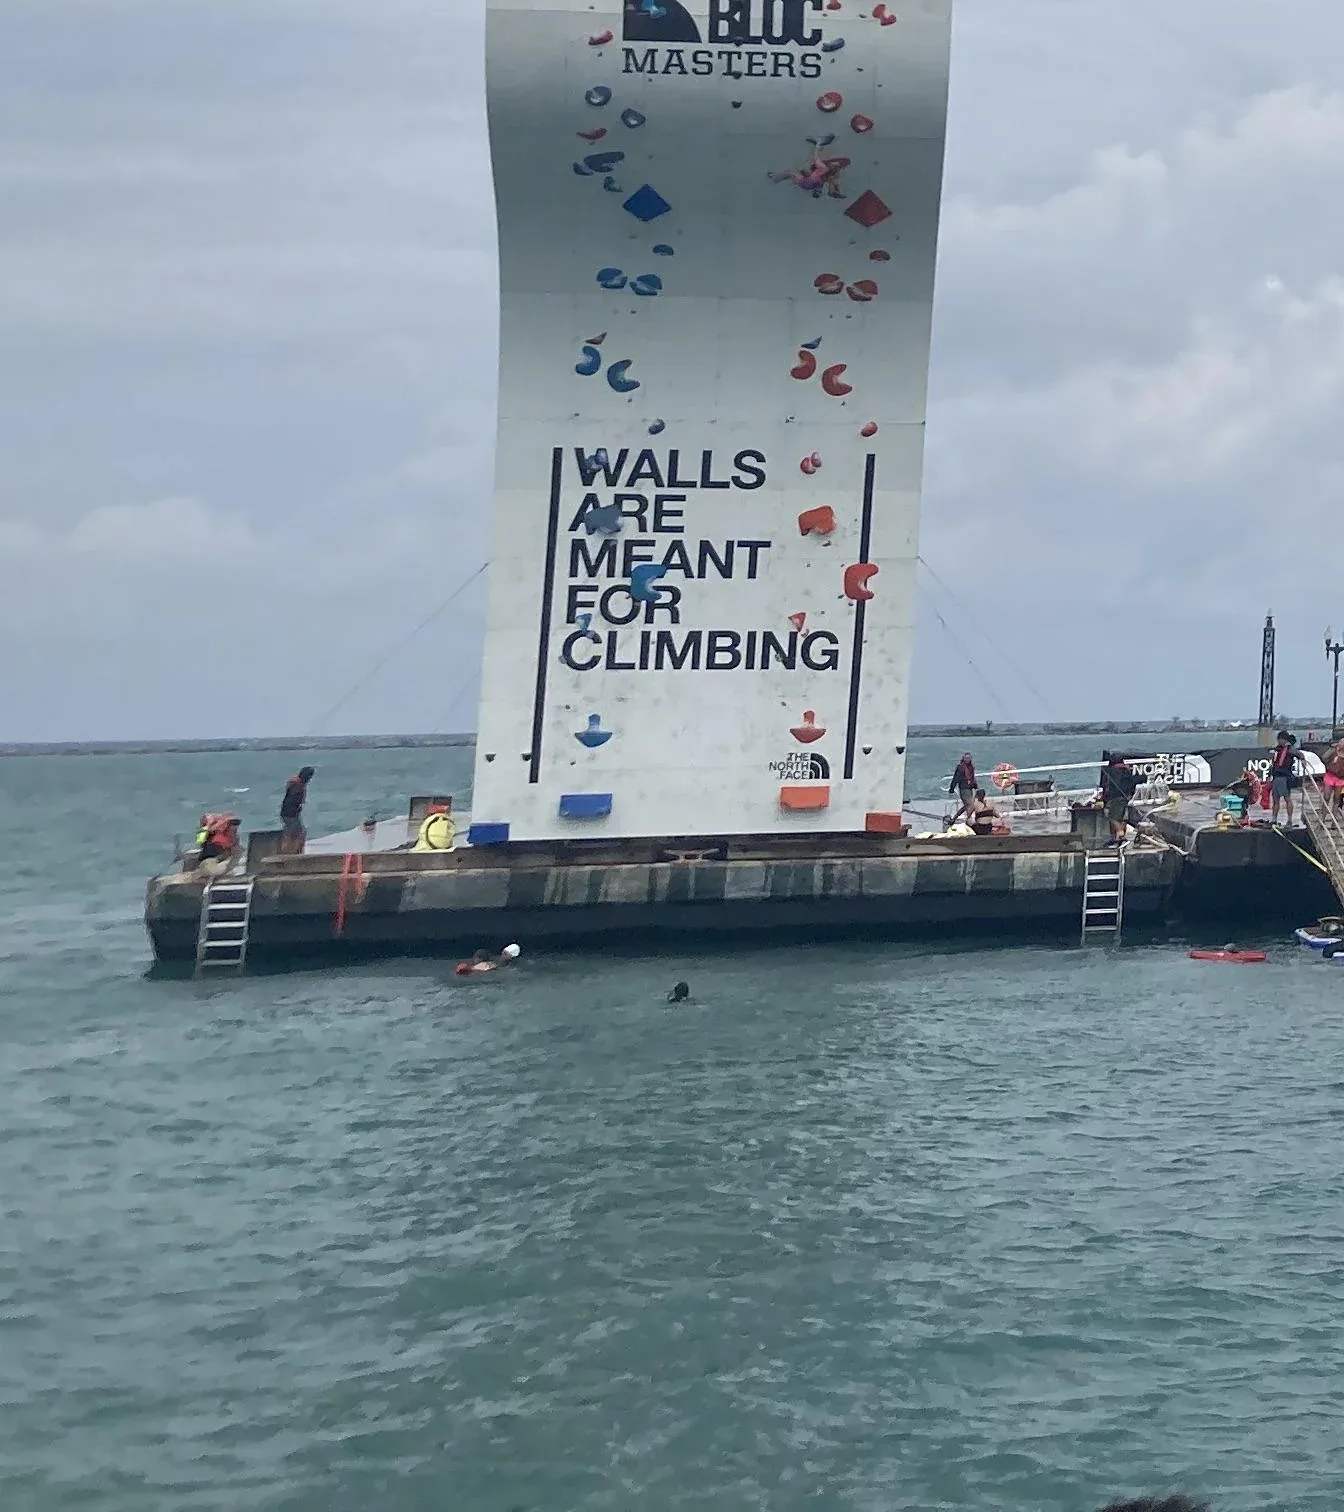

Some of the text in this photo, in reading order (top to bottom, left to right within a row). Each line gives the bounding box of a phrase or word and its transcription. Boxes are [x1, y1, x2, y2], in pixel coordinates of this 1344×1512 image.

[621, 48, 822, 78] MASTERS
[574, 447, 766, 489] WALLS
[568, 493, 686, 533] ARE
[569, 539, 771, 579] MEANT
[566, 584, 681, 625] FOR
[562, 630, 839, 671] CLIMBING
[768, 761, 810, 771] NORTH
[787, 752, 810, 761] THE
[1131, 763, 1184, 776] NORTH
[780, 770, 809, 779] FACE
